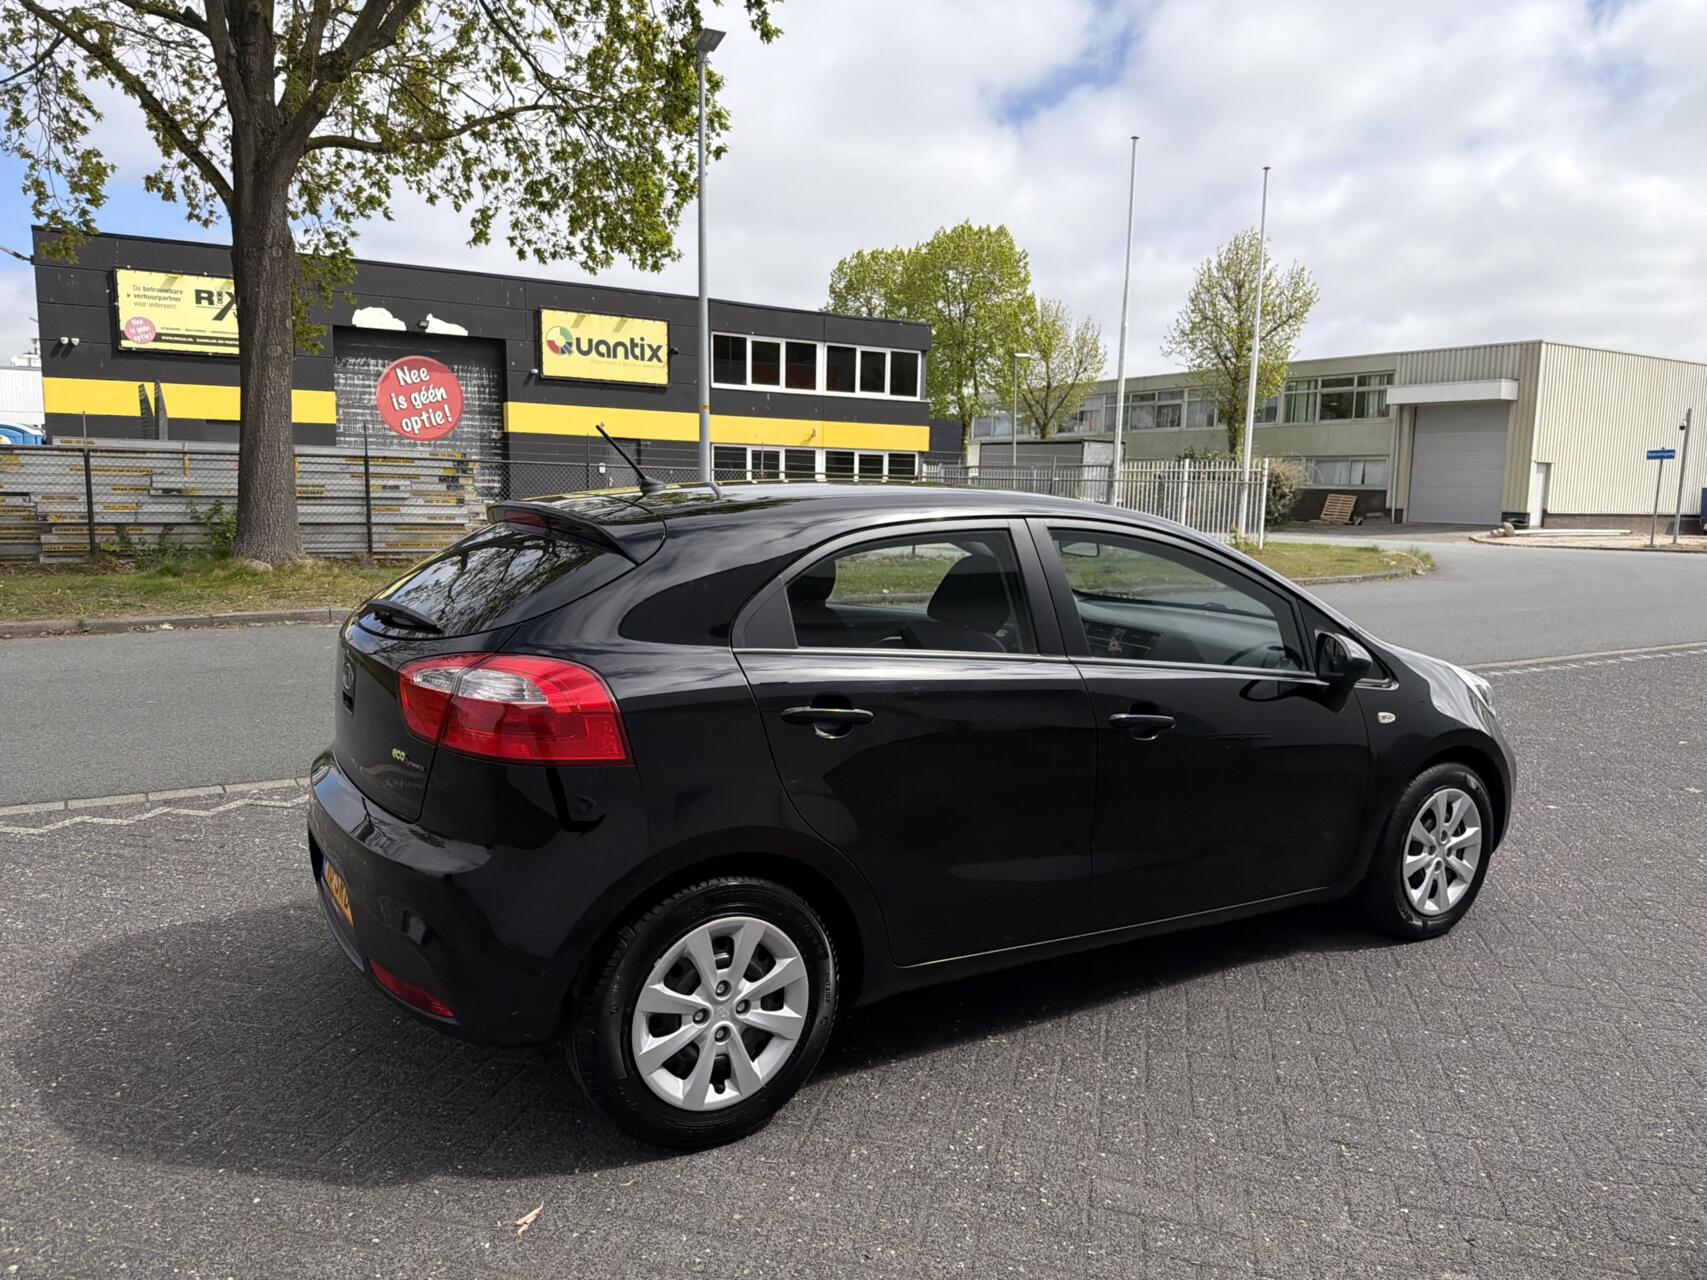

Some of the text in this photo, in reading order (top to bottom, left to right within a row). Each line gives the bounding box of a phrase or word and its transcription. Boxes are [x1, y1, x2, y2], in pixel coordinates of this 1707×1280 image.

[133, 294, 181, 302] verhuurpartner
[142, 286, 184, 295] betrouwbare
[395, 365, 430, 386] Nee
[390, 383, 448, 411] is géén
